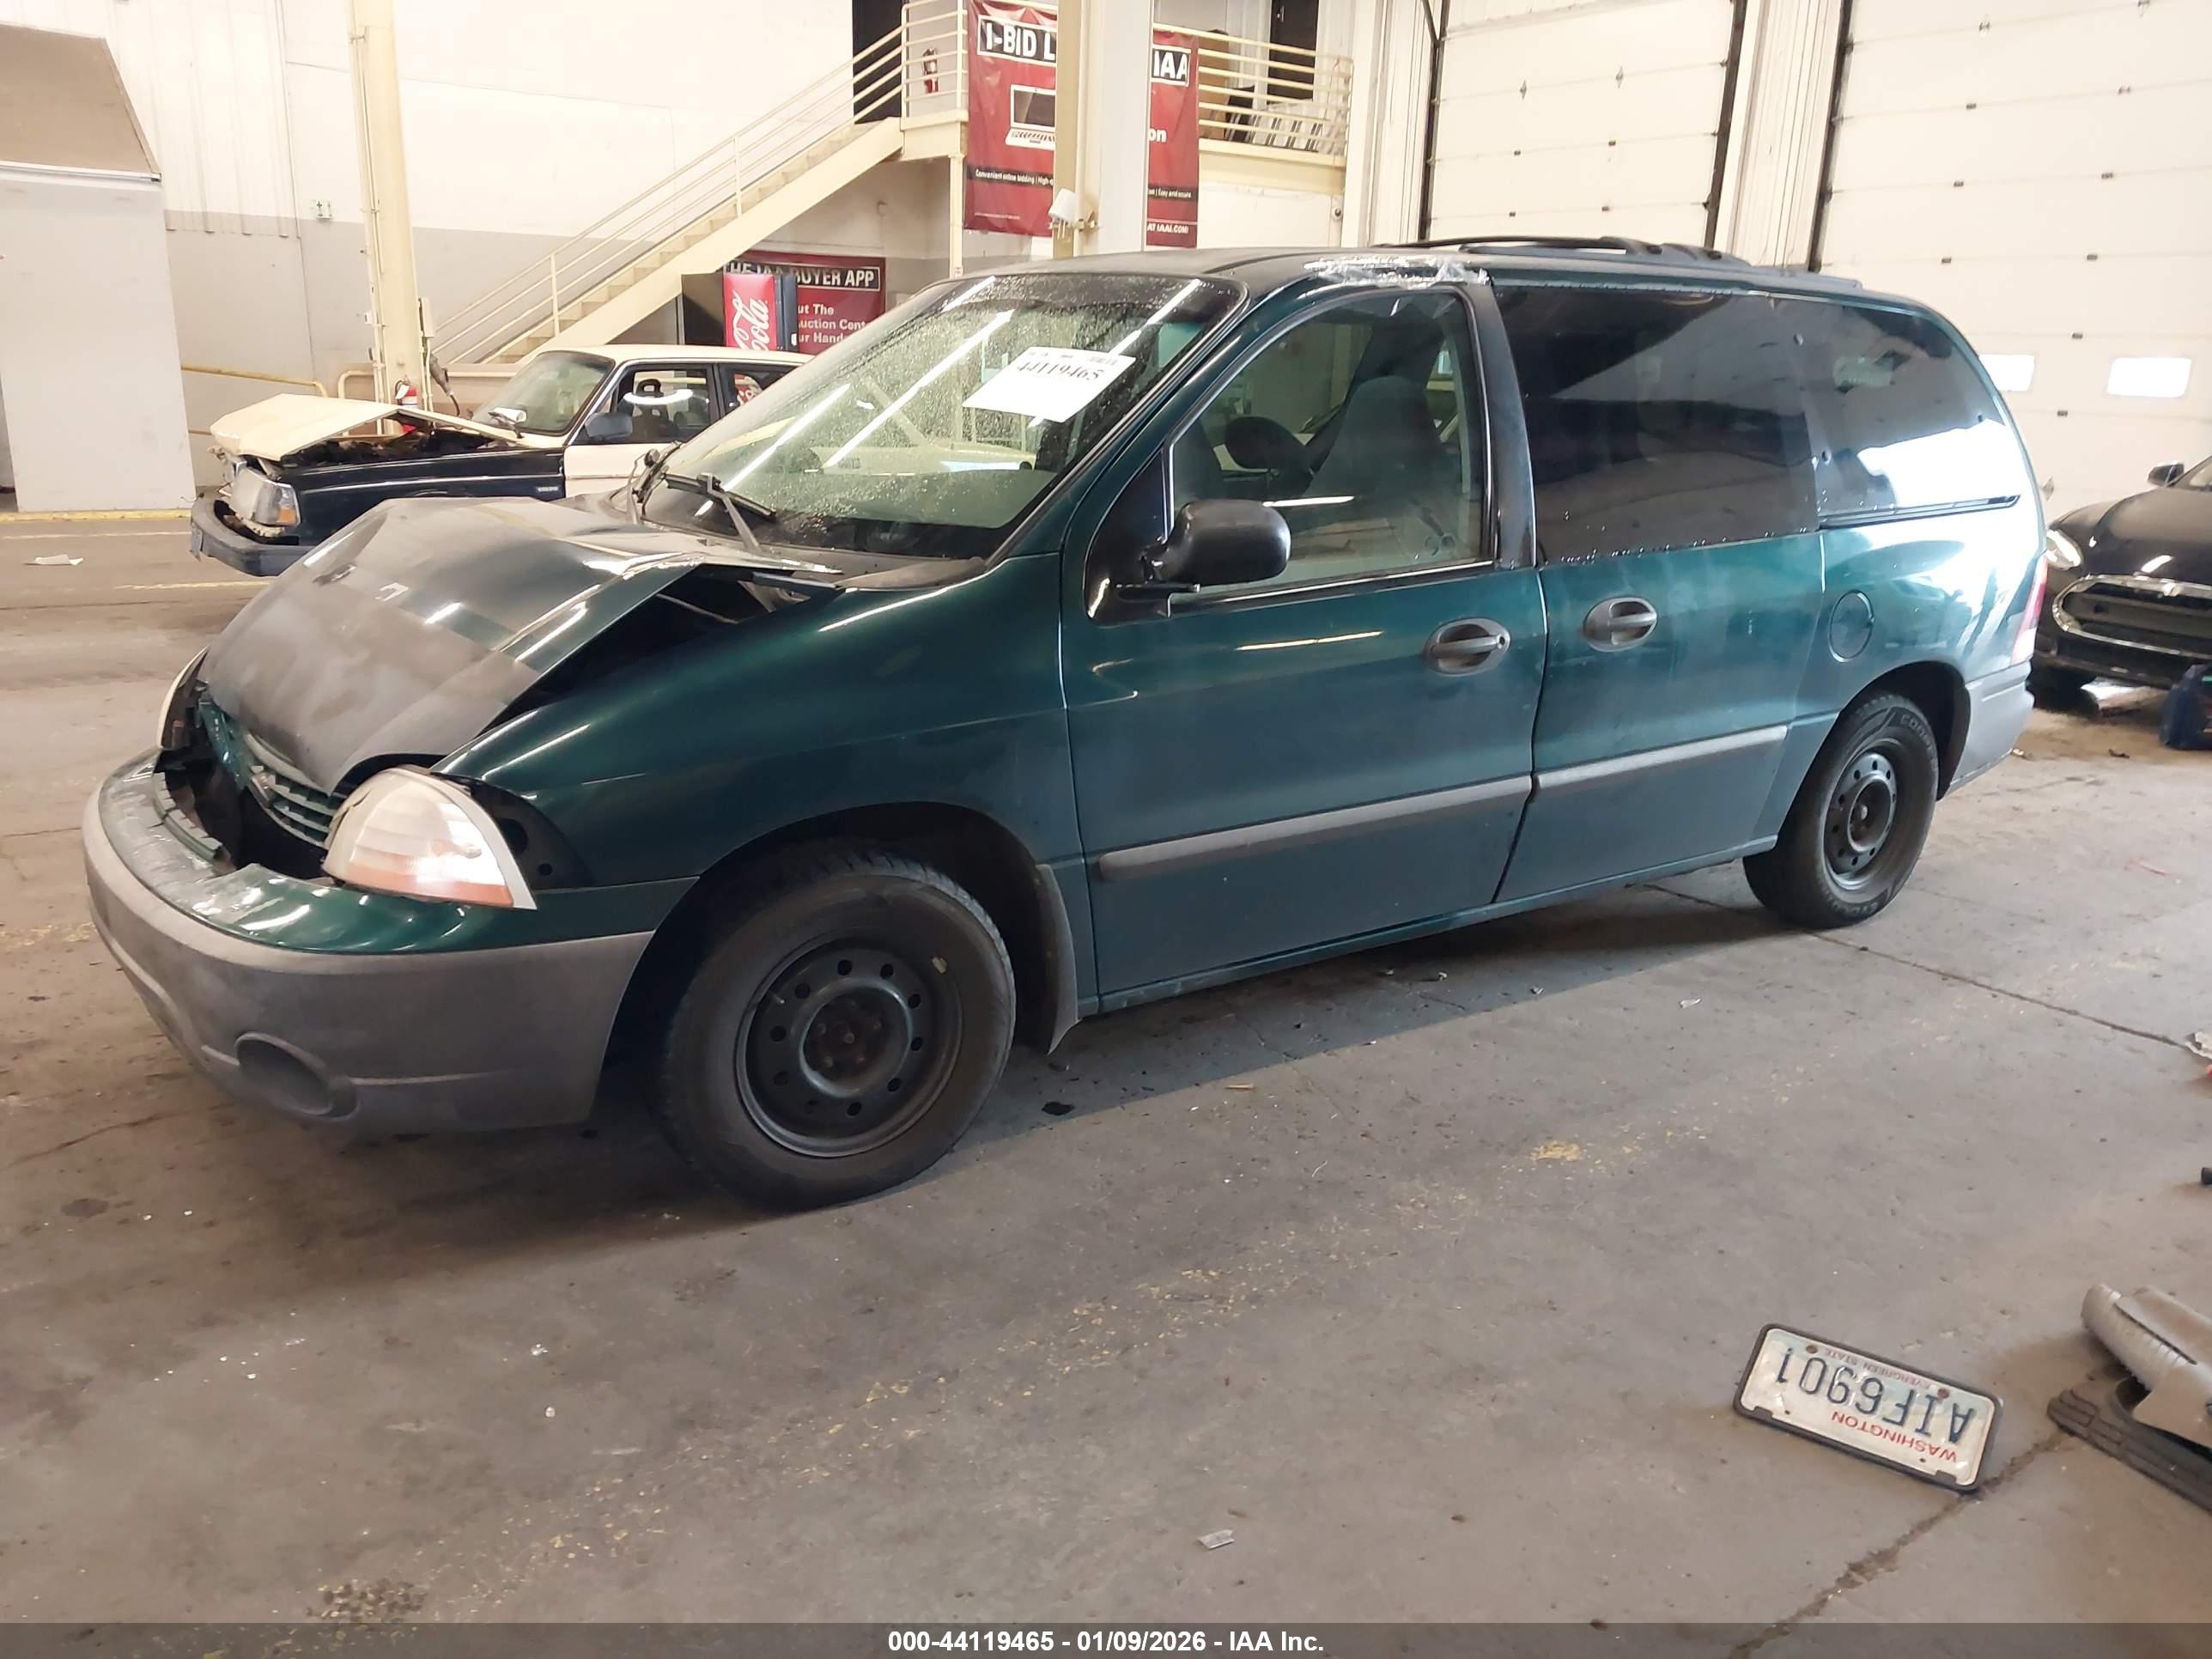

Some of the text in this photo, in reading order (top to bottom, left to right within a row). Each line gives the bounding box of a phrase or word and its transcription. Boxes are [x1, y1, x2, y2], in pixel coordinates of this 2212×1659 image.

[986, 22, 1037, 58] I-BID
[1153, 50, 1188, 80] IAA
[975, 168, 1003, 179] Convenient
[844, 270, 875, 287] APP
[812, 303, 835, 316] The
[1823, 1346, 1858, 1365] STATE
[1775, 1347, 1974, 1443] AIF6901
[1831, 1410, 1958, 1462] WASHINGTON
